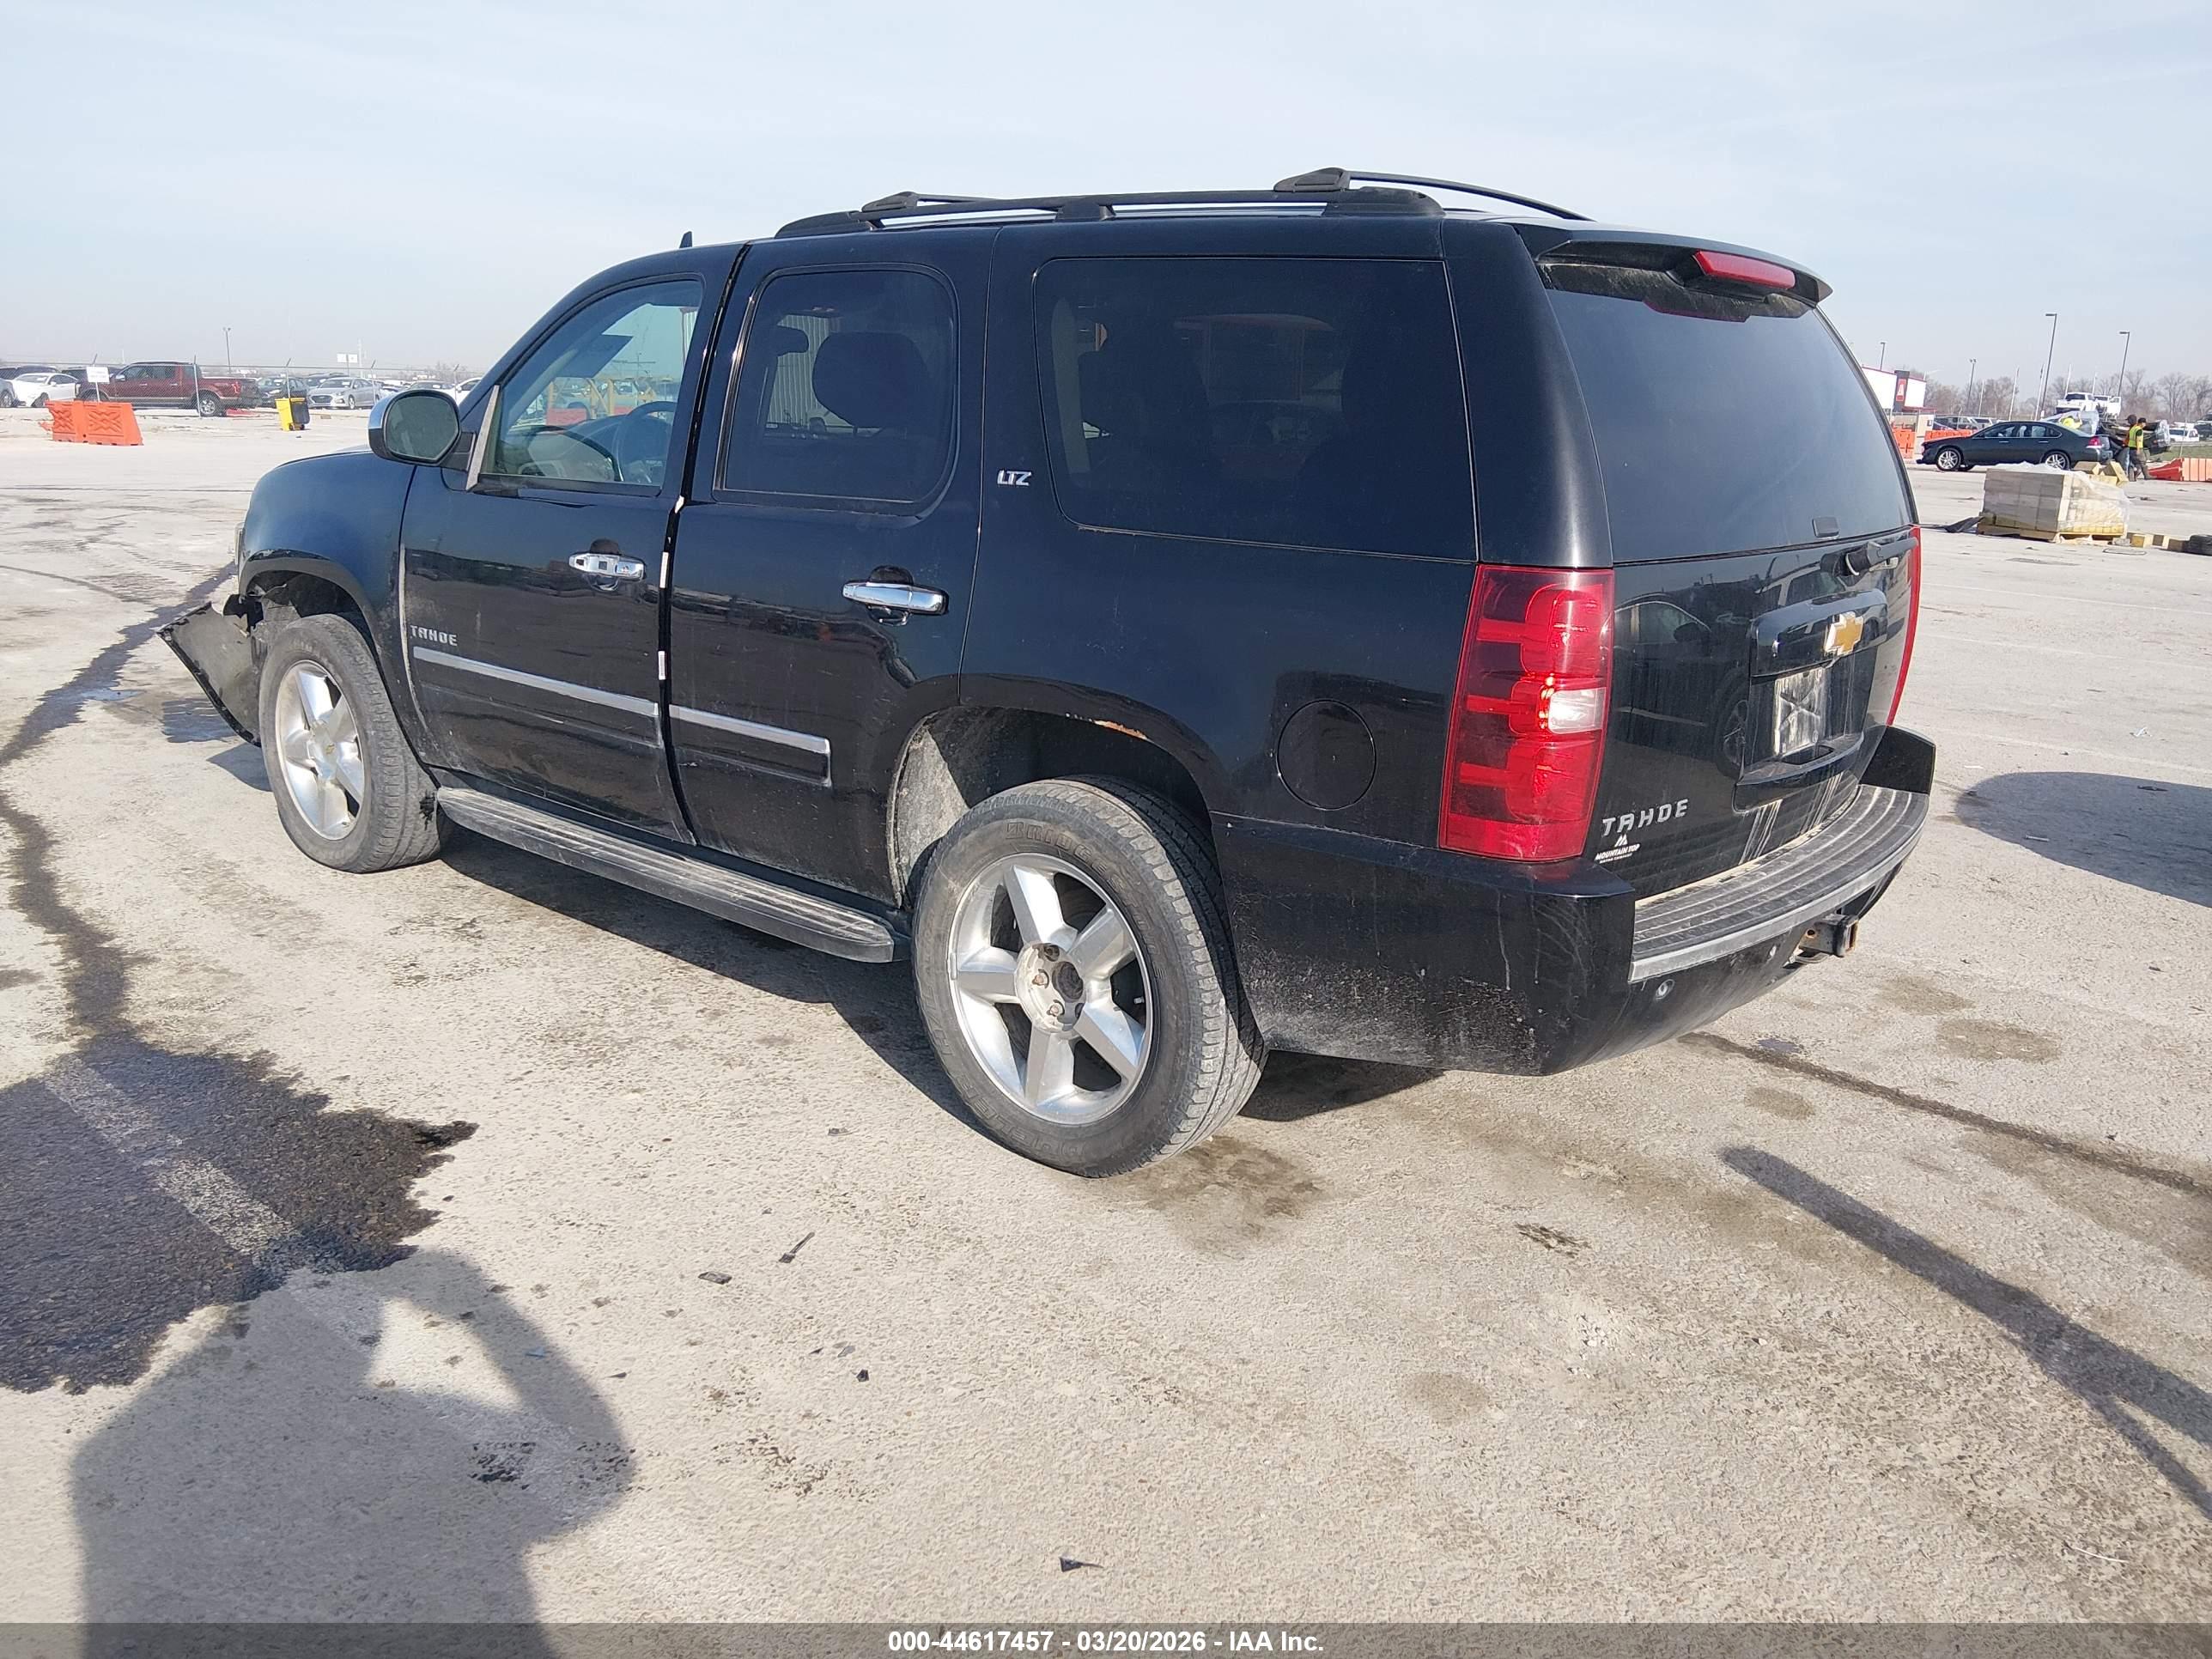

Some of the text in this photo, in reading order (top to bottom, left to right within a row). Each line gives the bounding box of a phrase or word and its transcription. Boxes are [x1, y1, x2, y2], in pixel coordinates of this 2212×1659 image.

[997, 470, 1032, 486] LTZ
[410, 624, 458, 647] TAHOE
[1601, 799, 1689, 837] TAHOE
[1594, 843, 1641, 860] MOUNTAIN TOP
[1006, 821, 1169, 980] BRIDGESTONE
